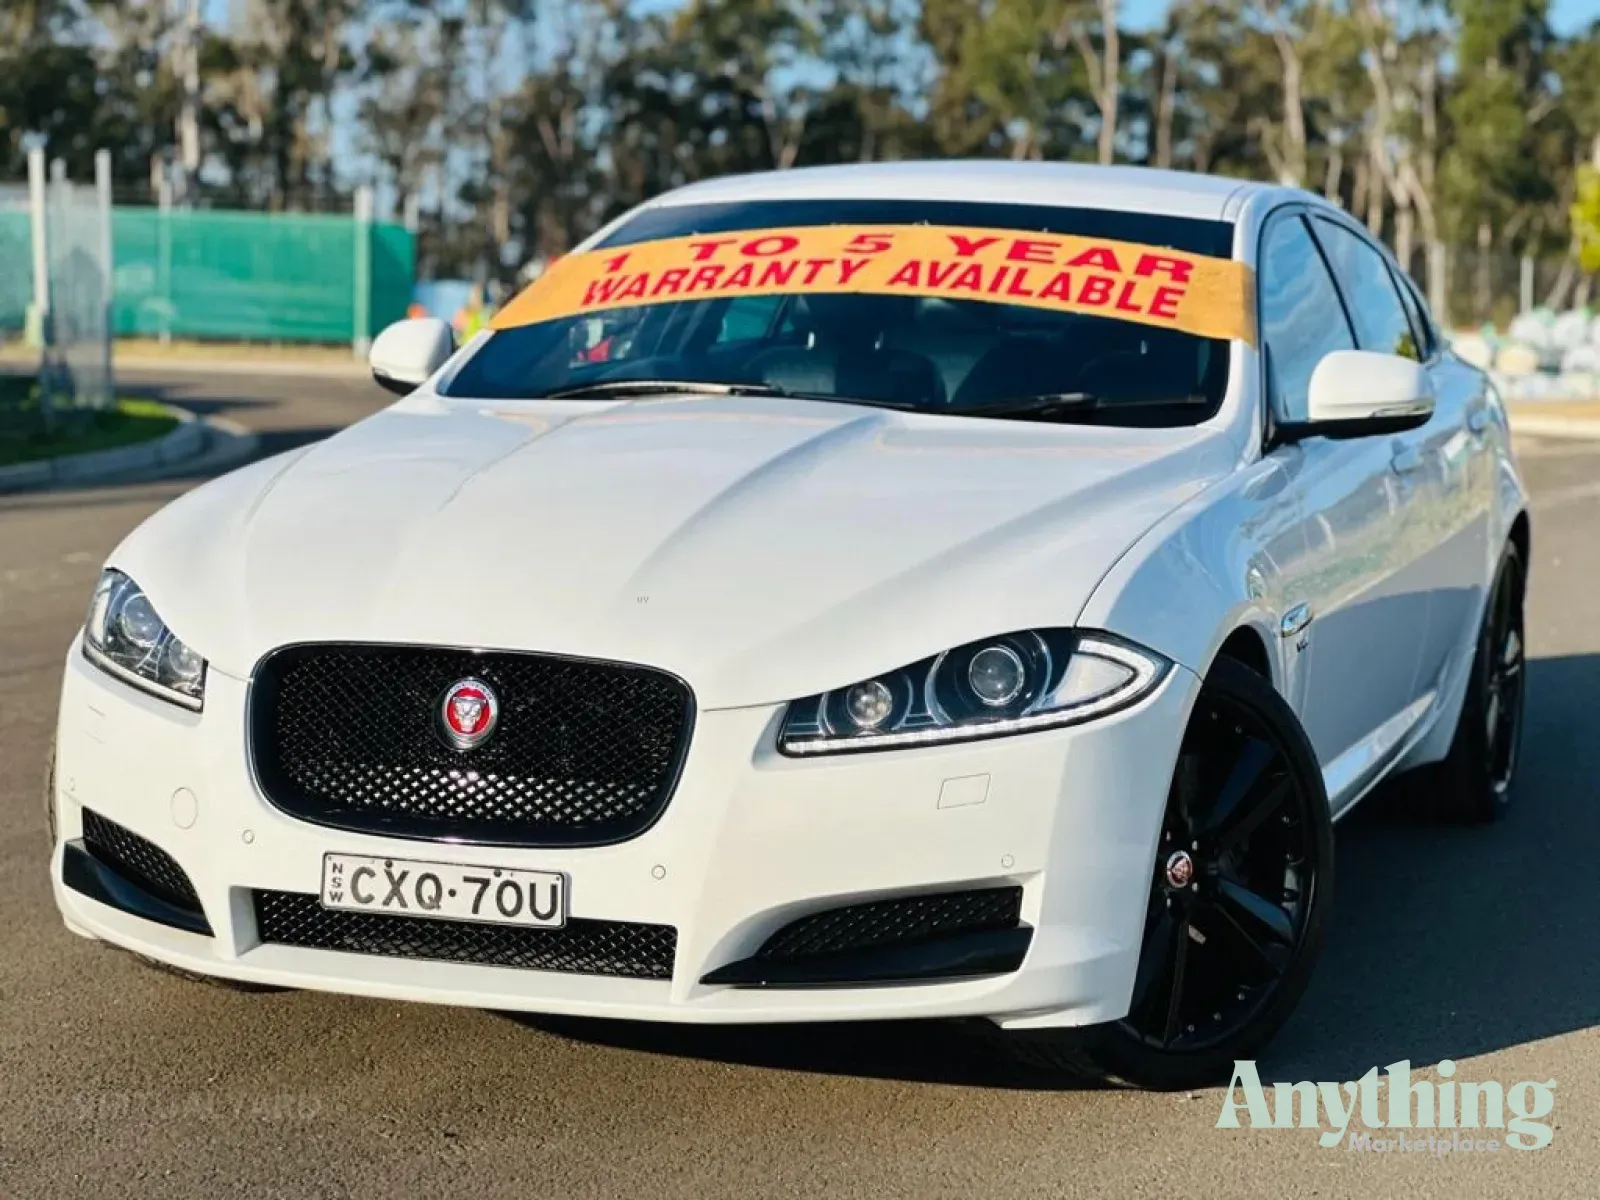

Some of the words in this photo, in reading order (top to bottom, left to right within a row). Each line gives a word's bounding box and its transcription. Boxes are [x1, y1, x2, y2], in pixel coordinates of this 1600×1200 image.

[604, 252, 631, 273] 1
[688, 236, 799, 262] TO
[843, 234, 892, 254] 5
[946, 235, 1194, 284] YEAR
[580, 258, 870, 306] WARRANTY
[885, 260, 1186, 319] AVAILABLE
